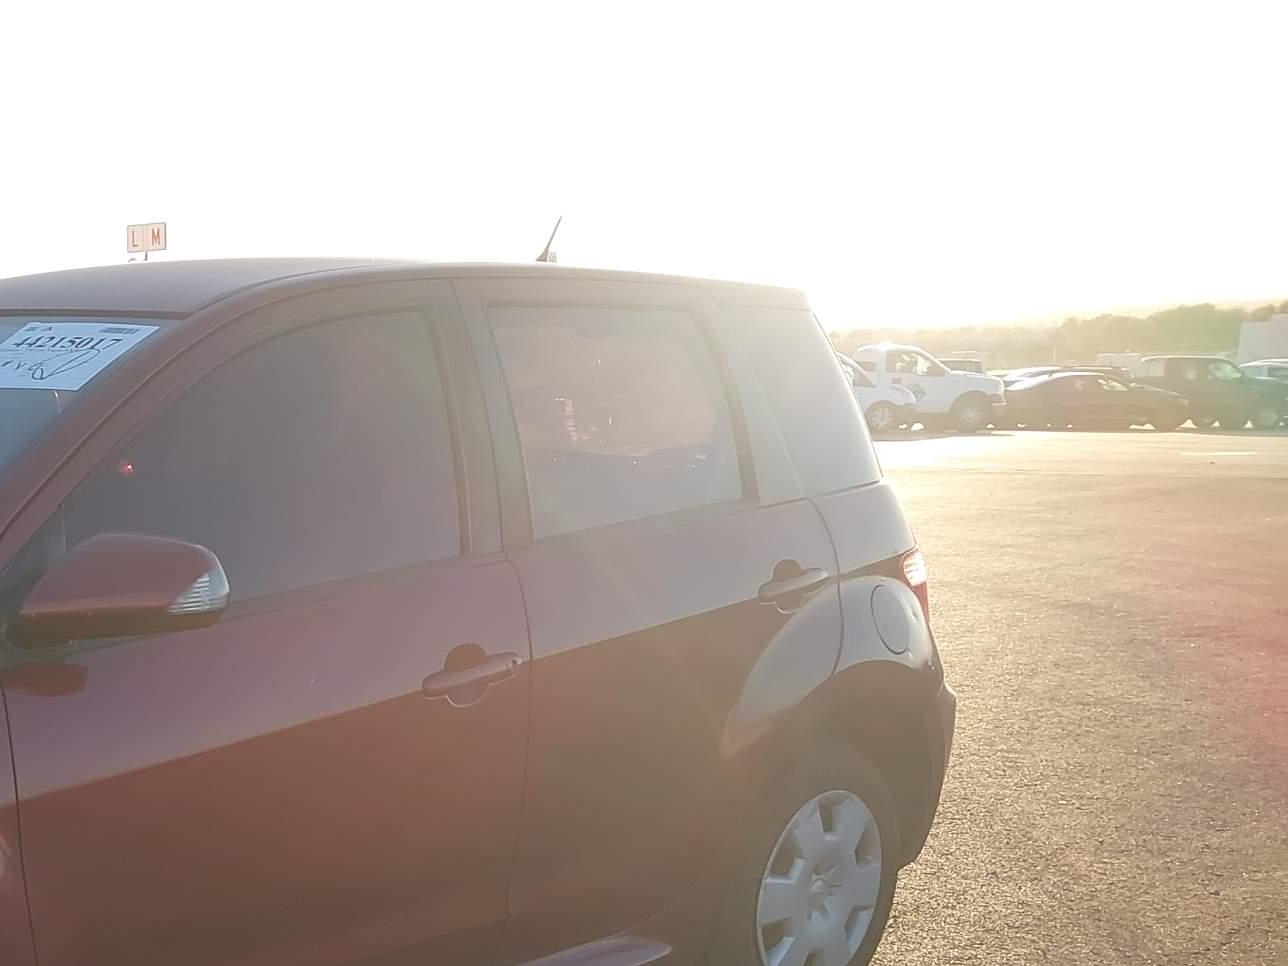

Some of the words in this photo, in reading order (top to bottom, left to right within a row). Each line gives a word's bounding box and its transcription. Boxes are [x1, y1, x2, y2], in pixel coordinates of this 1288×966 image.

[131, 230, 139, 247] L
[152, 228, 161, 246] M
[12, 335, 125, 350] 44215017
